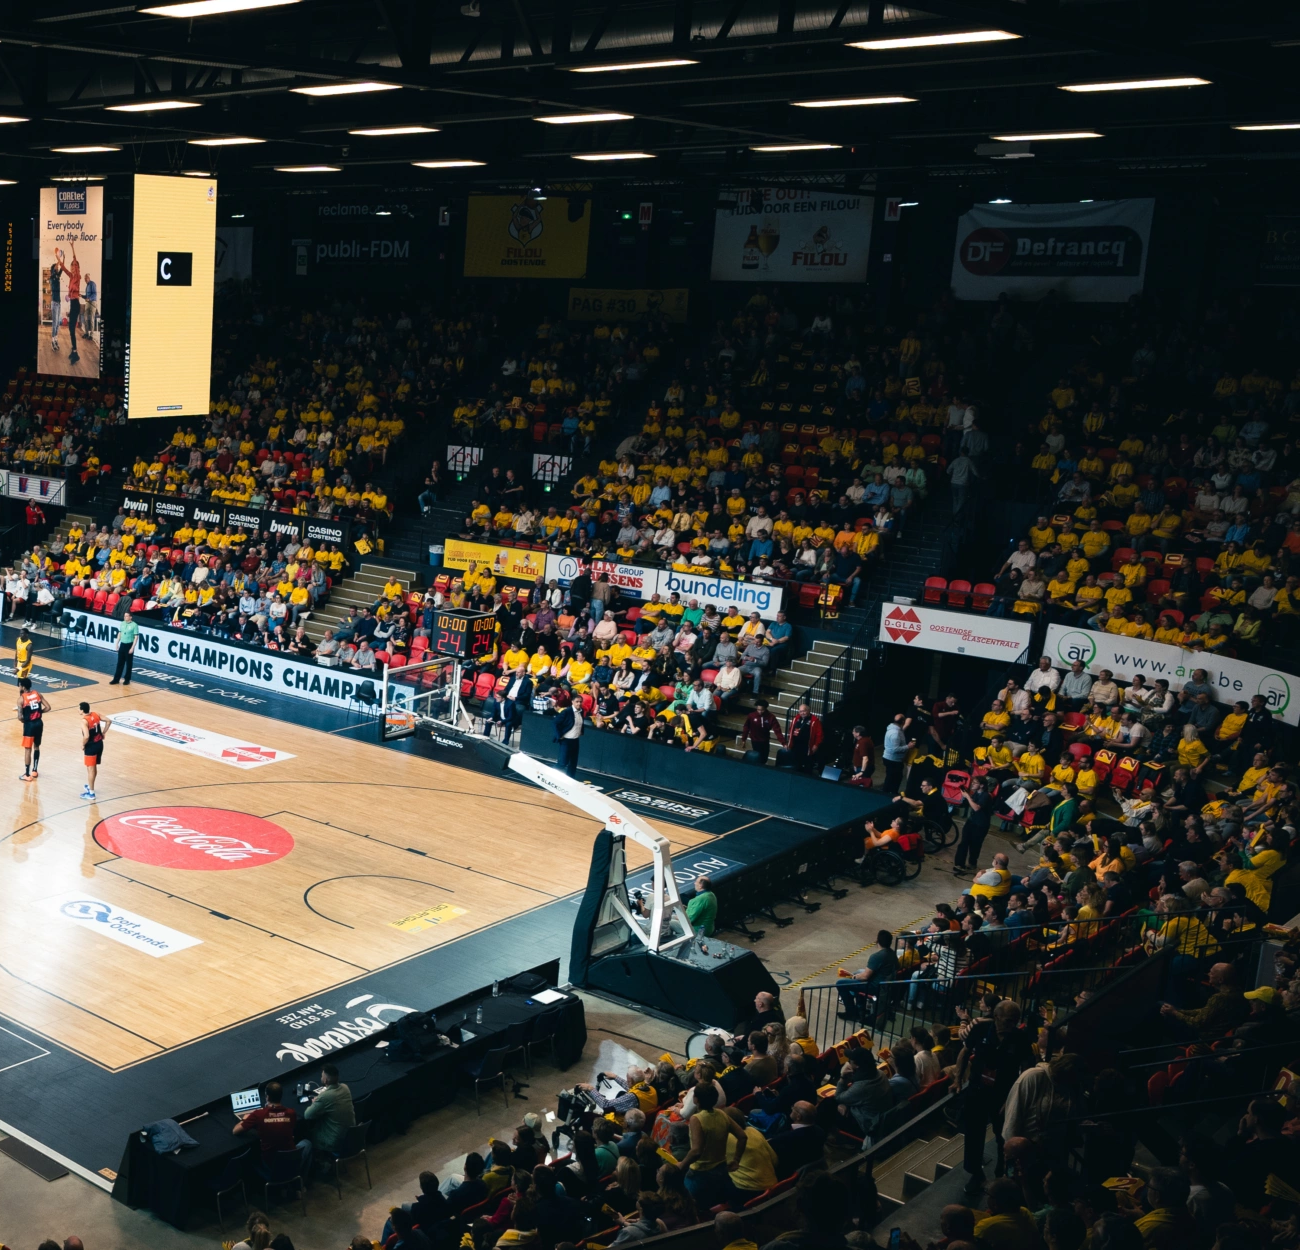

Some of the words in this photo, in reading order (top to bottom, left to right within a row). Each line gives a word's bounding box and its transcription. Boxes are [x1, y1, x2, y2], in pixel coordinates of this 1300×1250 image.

[640, 205, 652, 221] M
[794, 202, 817, 213] EEN
[820, 198, 860, 212] FILOU!
[888, 201, 899, 217] N
[47, 220, 84, 231] Everybody
[66, 232, 79, 242] the
[80, 231, 97, 242] floor
[316, 240, 410, 263] publi-FDM
[507, 247, 542, 258] FILOU
[791, 251, 848, 266] FILOU
[1016, 237, 1126, 267] Defrancq
[160, 257, 172, 280] C
[571, 297, 603, 313] PAG
[606, 298, 636, 313] #30
[123, 497, 149, 512] bwin
[156, 502, 185, 512] CASINO
[156, 508, 185, 518] OOSTENDE
[193, 507, 220, 523] bwin
[228, 513, 260, 524] CASINO
[228, 519, 259, 530] OOSTENDE
[270, 519, 299, 535] bwin
[308, 525, 342, 537] CASINO
[308, 532, 342, 543] OOSTENDE
[512, 564, 539, 576] FILOU
[618, 566, 644, 577] GROUP
[665, 572, 771, 610] bundeling
[438, 616, 467, 632] 10:00
[473, 617, 495, 632] 10:00
[884, 619, 922, 631] D-GLAS
[929, 624, 973, 636] OOSTENDSE
[437, 630, 461, 653] 24
[472, 633, 491, 654] 24
[962, 635, 1020, 649] GLASCENTRALE
[167, 639, 274, 681] CHAMPIONS
[206, 687, 267, 705] DOME
[30, 700, 39, 710] 15
[621, 790, 710, 816] CASINO
[112, 914, 141, 931] Port
[110, 923, 170, 950] Oostende
[296, 1003, 324, 1015] AAN
[319, 1008, 337, 1019] DE
[275, 1010, 301, 1024] ZEE
[289, 1013, 321, 1030] STAD
